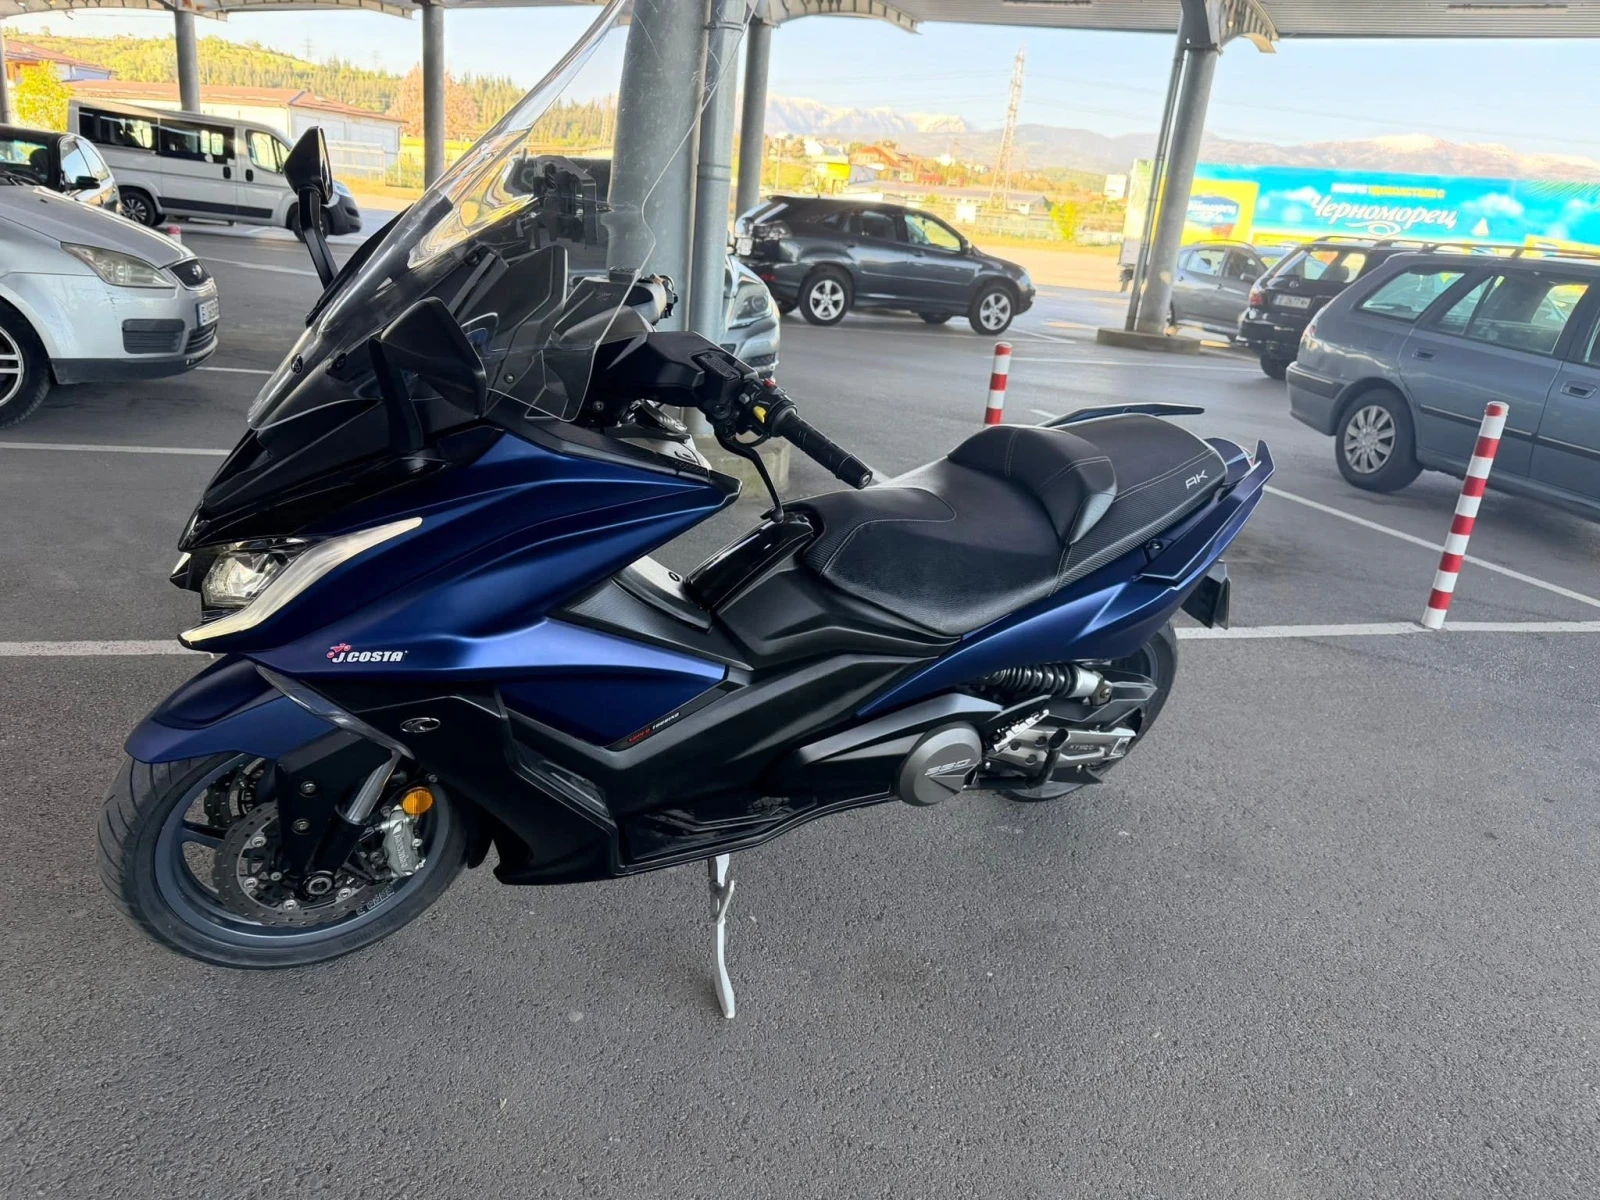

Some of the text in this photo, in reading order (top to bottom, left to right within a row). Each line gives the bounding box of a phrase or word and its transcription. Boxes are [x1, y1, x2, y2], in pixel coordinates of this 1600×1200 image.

[1310, 195, 1458, 230] Черноморец
[1185, 470, 1208, 489] AK
[331, 651, 404, 663] J.COSTA
